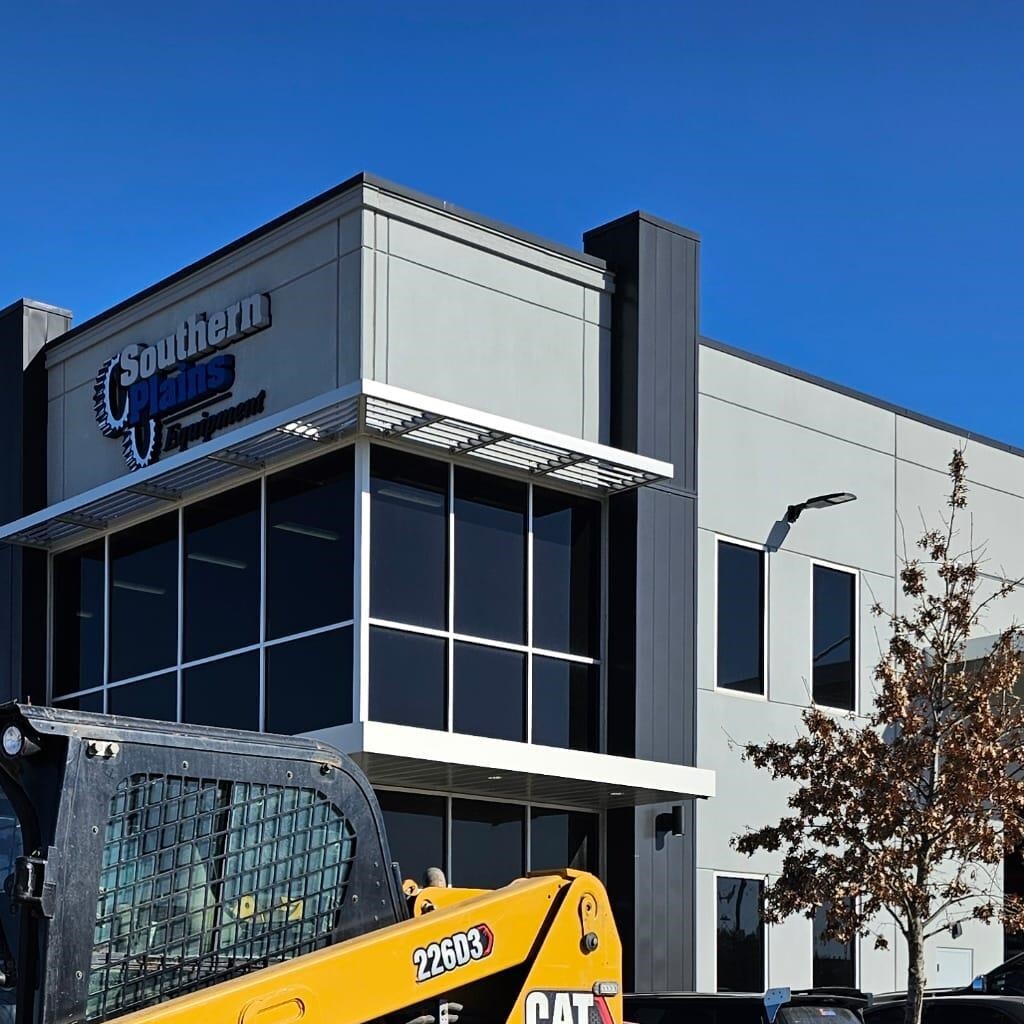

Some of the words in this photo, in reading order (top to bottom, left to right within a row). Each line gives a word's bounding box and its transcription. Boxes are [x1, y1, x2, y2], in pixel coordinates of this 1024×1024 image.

[120, 293, 269, 386] Southern
[128, 354, 235, 425] Plains
[163, 390, 267, 451] Equipment
[413, 927, 483, 982] 226D3
